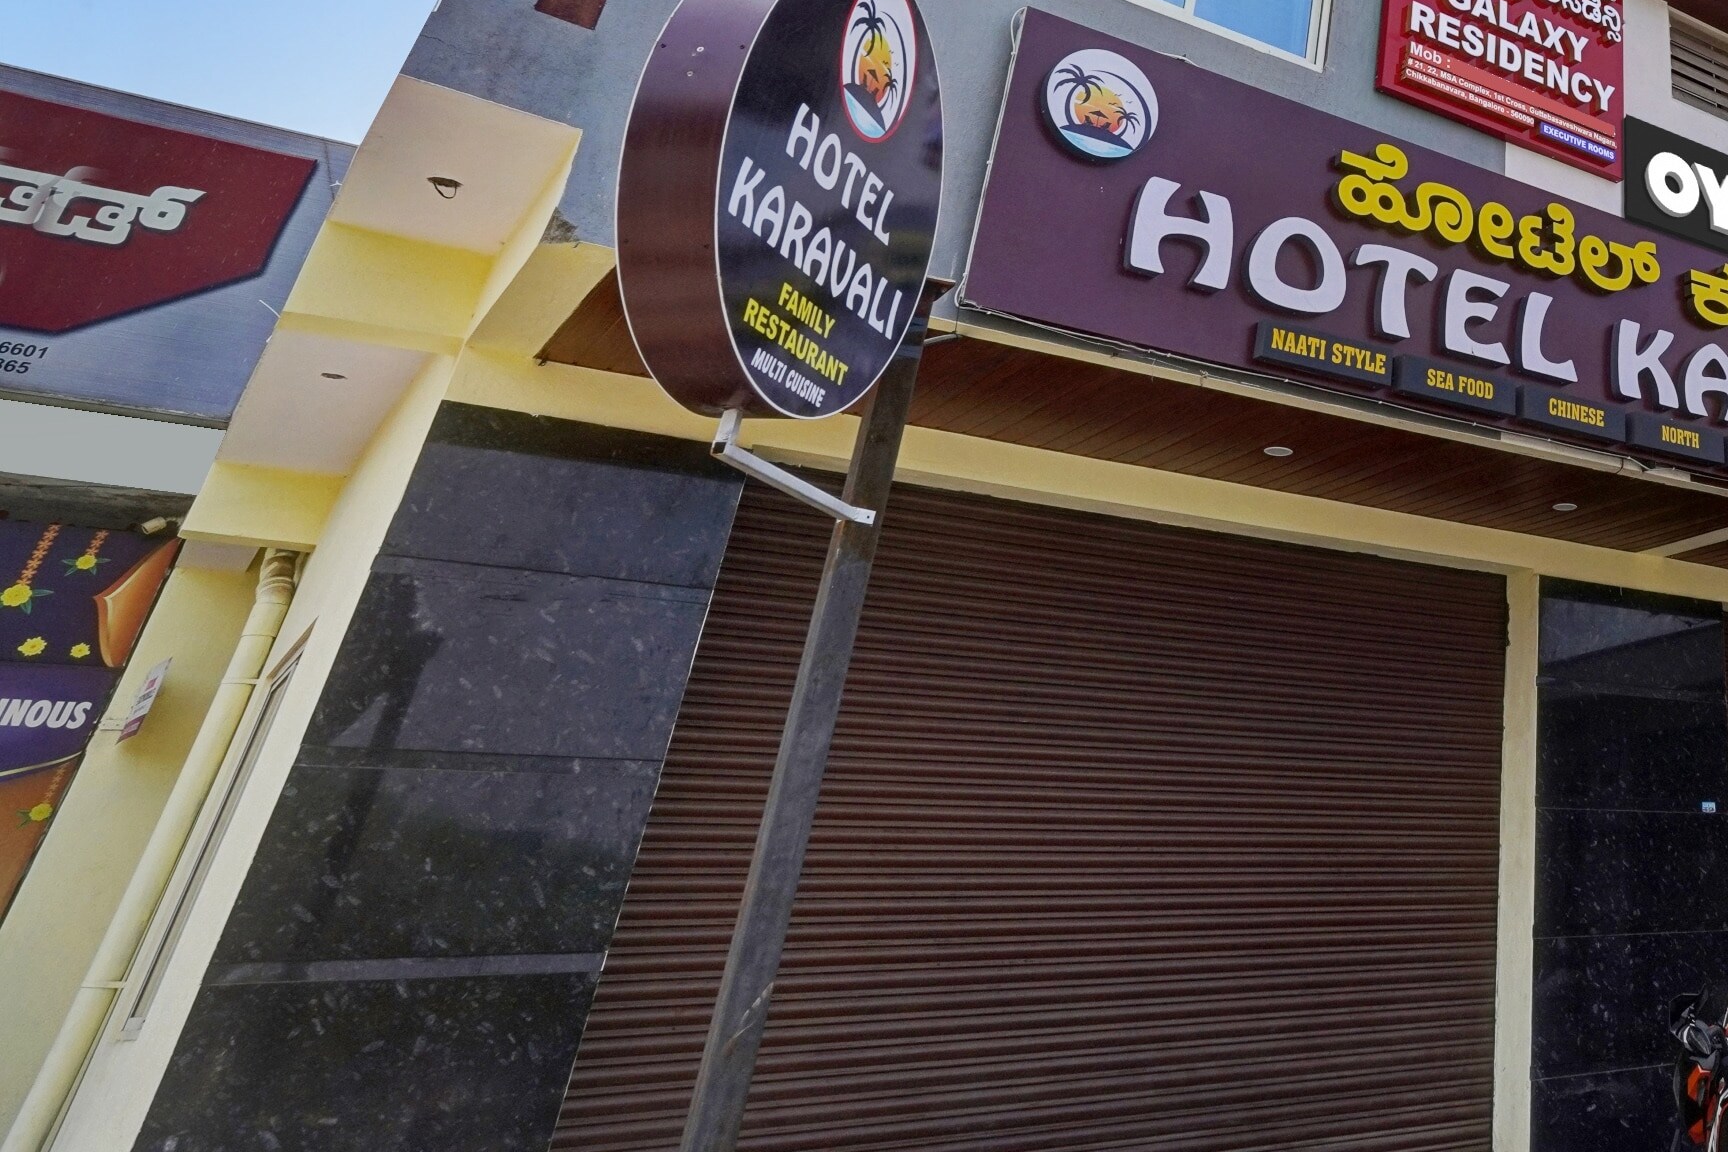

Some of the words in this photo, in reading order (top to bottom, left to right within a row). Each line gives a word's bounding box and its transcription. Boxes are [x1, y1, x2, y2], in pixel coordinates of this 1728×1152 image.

[1410, 41, 1442, 65] Mob
[1410, 0, 1616, 112] RESIDENCY
[1405, 68, 1468, 100] Chikkabanavara,
[1468, 92, 1505, 114] Bangalore
[1510, 110, 1535, 126] 560090
[1440, 71, 1457, 84] MSA
[1458, 77, 1492, 99] Complex,
[1493, 92, 1505, 103] 1st
[1505, 97, 1528, 113] Cross,
[1543, 124, 1587, 149] EXECUTIVE
[1587, 143, 1615, 160] ROOMS
[786, 102, 895, 246] HOTEL
[1337, 143, 1662, 292] ಹೋಟೆಲ್
[727, 155, 902, 342] KARAVALI
[1129, 175, 1579, 383] HOTEL
[779, 281, 836, 340] FAMILY
[0, 341, 49, 359] 6601
[743, 297, 848, 387] RESTAURANT
[1271, 327, 1328, 360] NAATI
[1331, 342, 1387, 375] STYLE
[751, 347, 786, 387] MULTI
[785, 368, 827, 409] CUISINE
[1426, 368, 1454, 393] SEA
[1458, 375, 1494, 401] FOOD
[1548, 397, 1606, 428] CHINESE
[1661, 425, 1700, 449] NORTH
